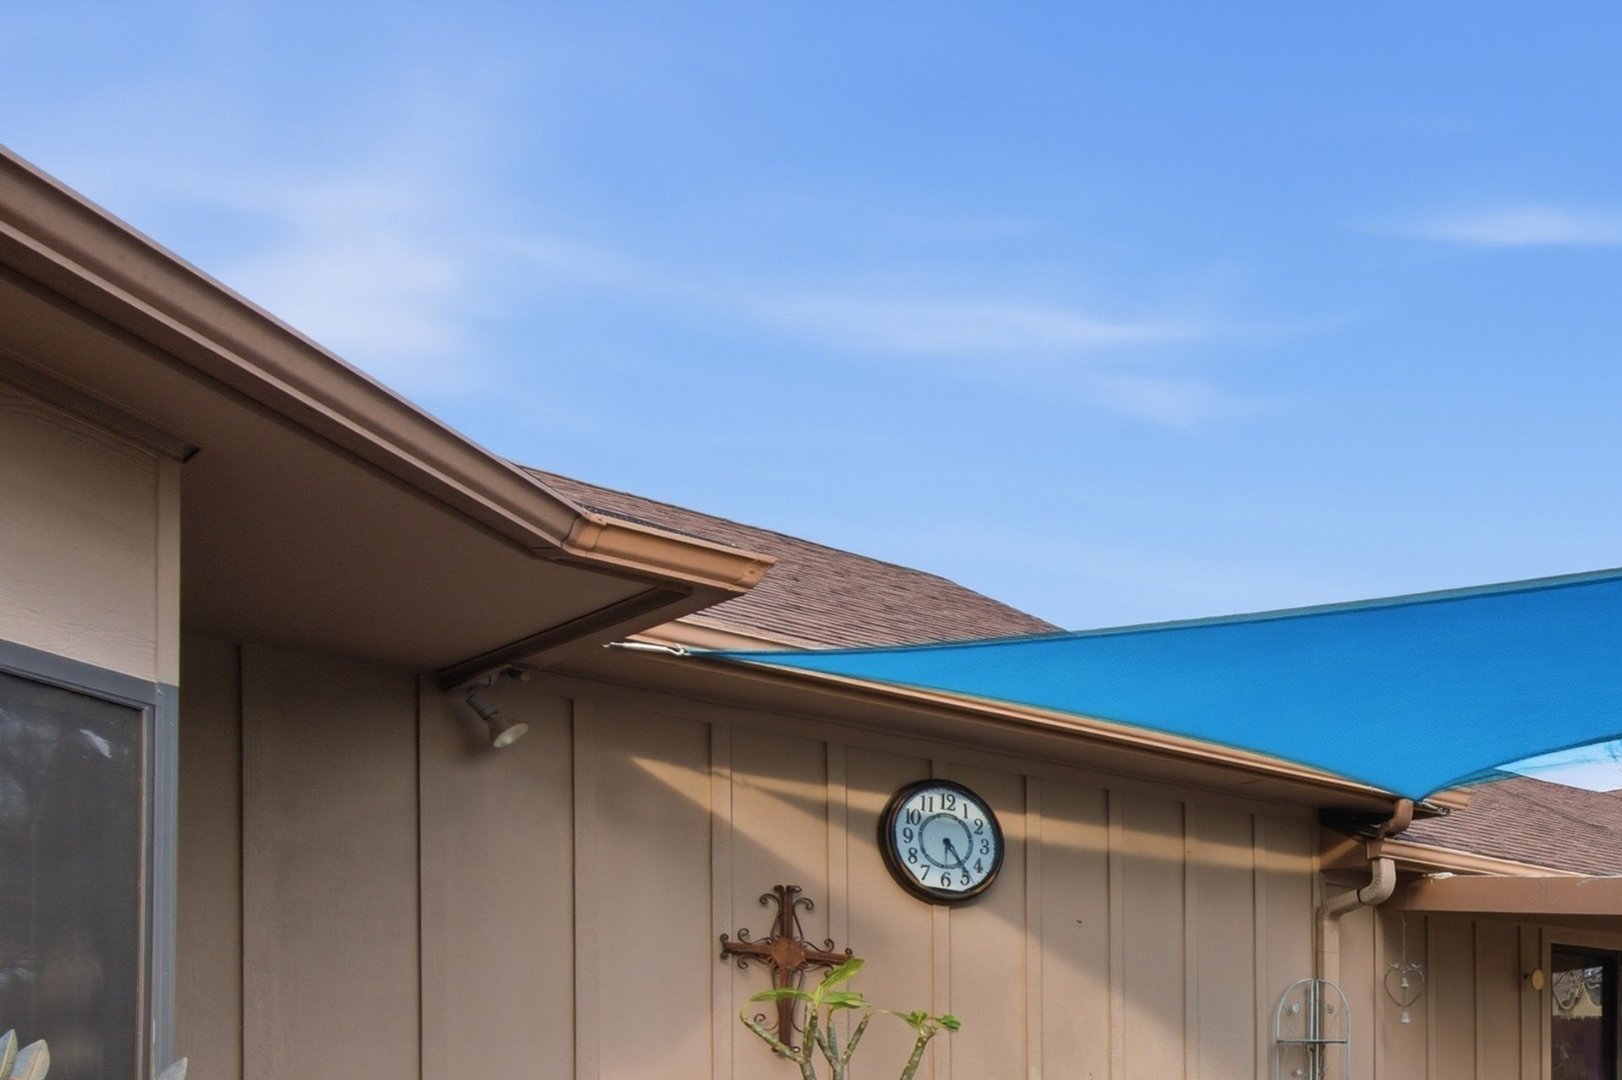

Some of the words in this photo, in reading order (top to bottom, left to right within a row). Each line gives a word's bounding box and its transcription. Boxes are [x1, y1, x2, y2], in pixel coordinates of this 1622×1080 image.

[921, 795, 934, 812] 11
[941, 793, 956, 811] 12
[906, 808, 921, 825] 10
[963, 803, 969, 819] 1
[974, 818, 984, 835] 2
[903, 827, 914, 843] 9
[980, 839, 990, 855] 3
[908, 847, 918, 864] 8
[920, 865, 931, 880] 7
[973, 858, 983, 873] 4
[941, 872, 951, 887] 6
[960, 870, 970, 885] 5
